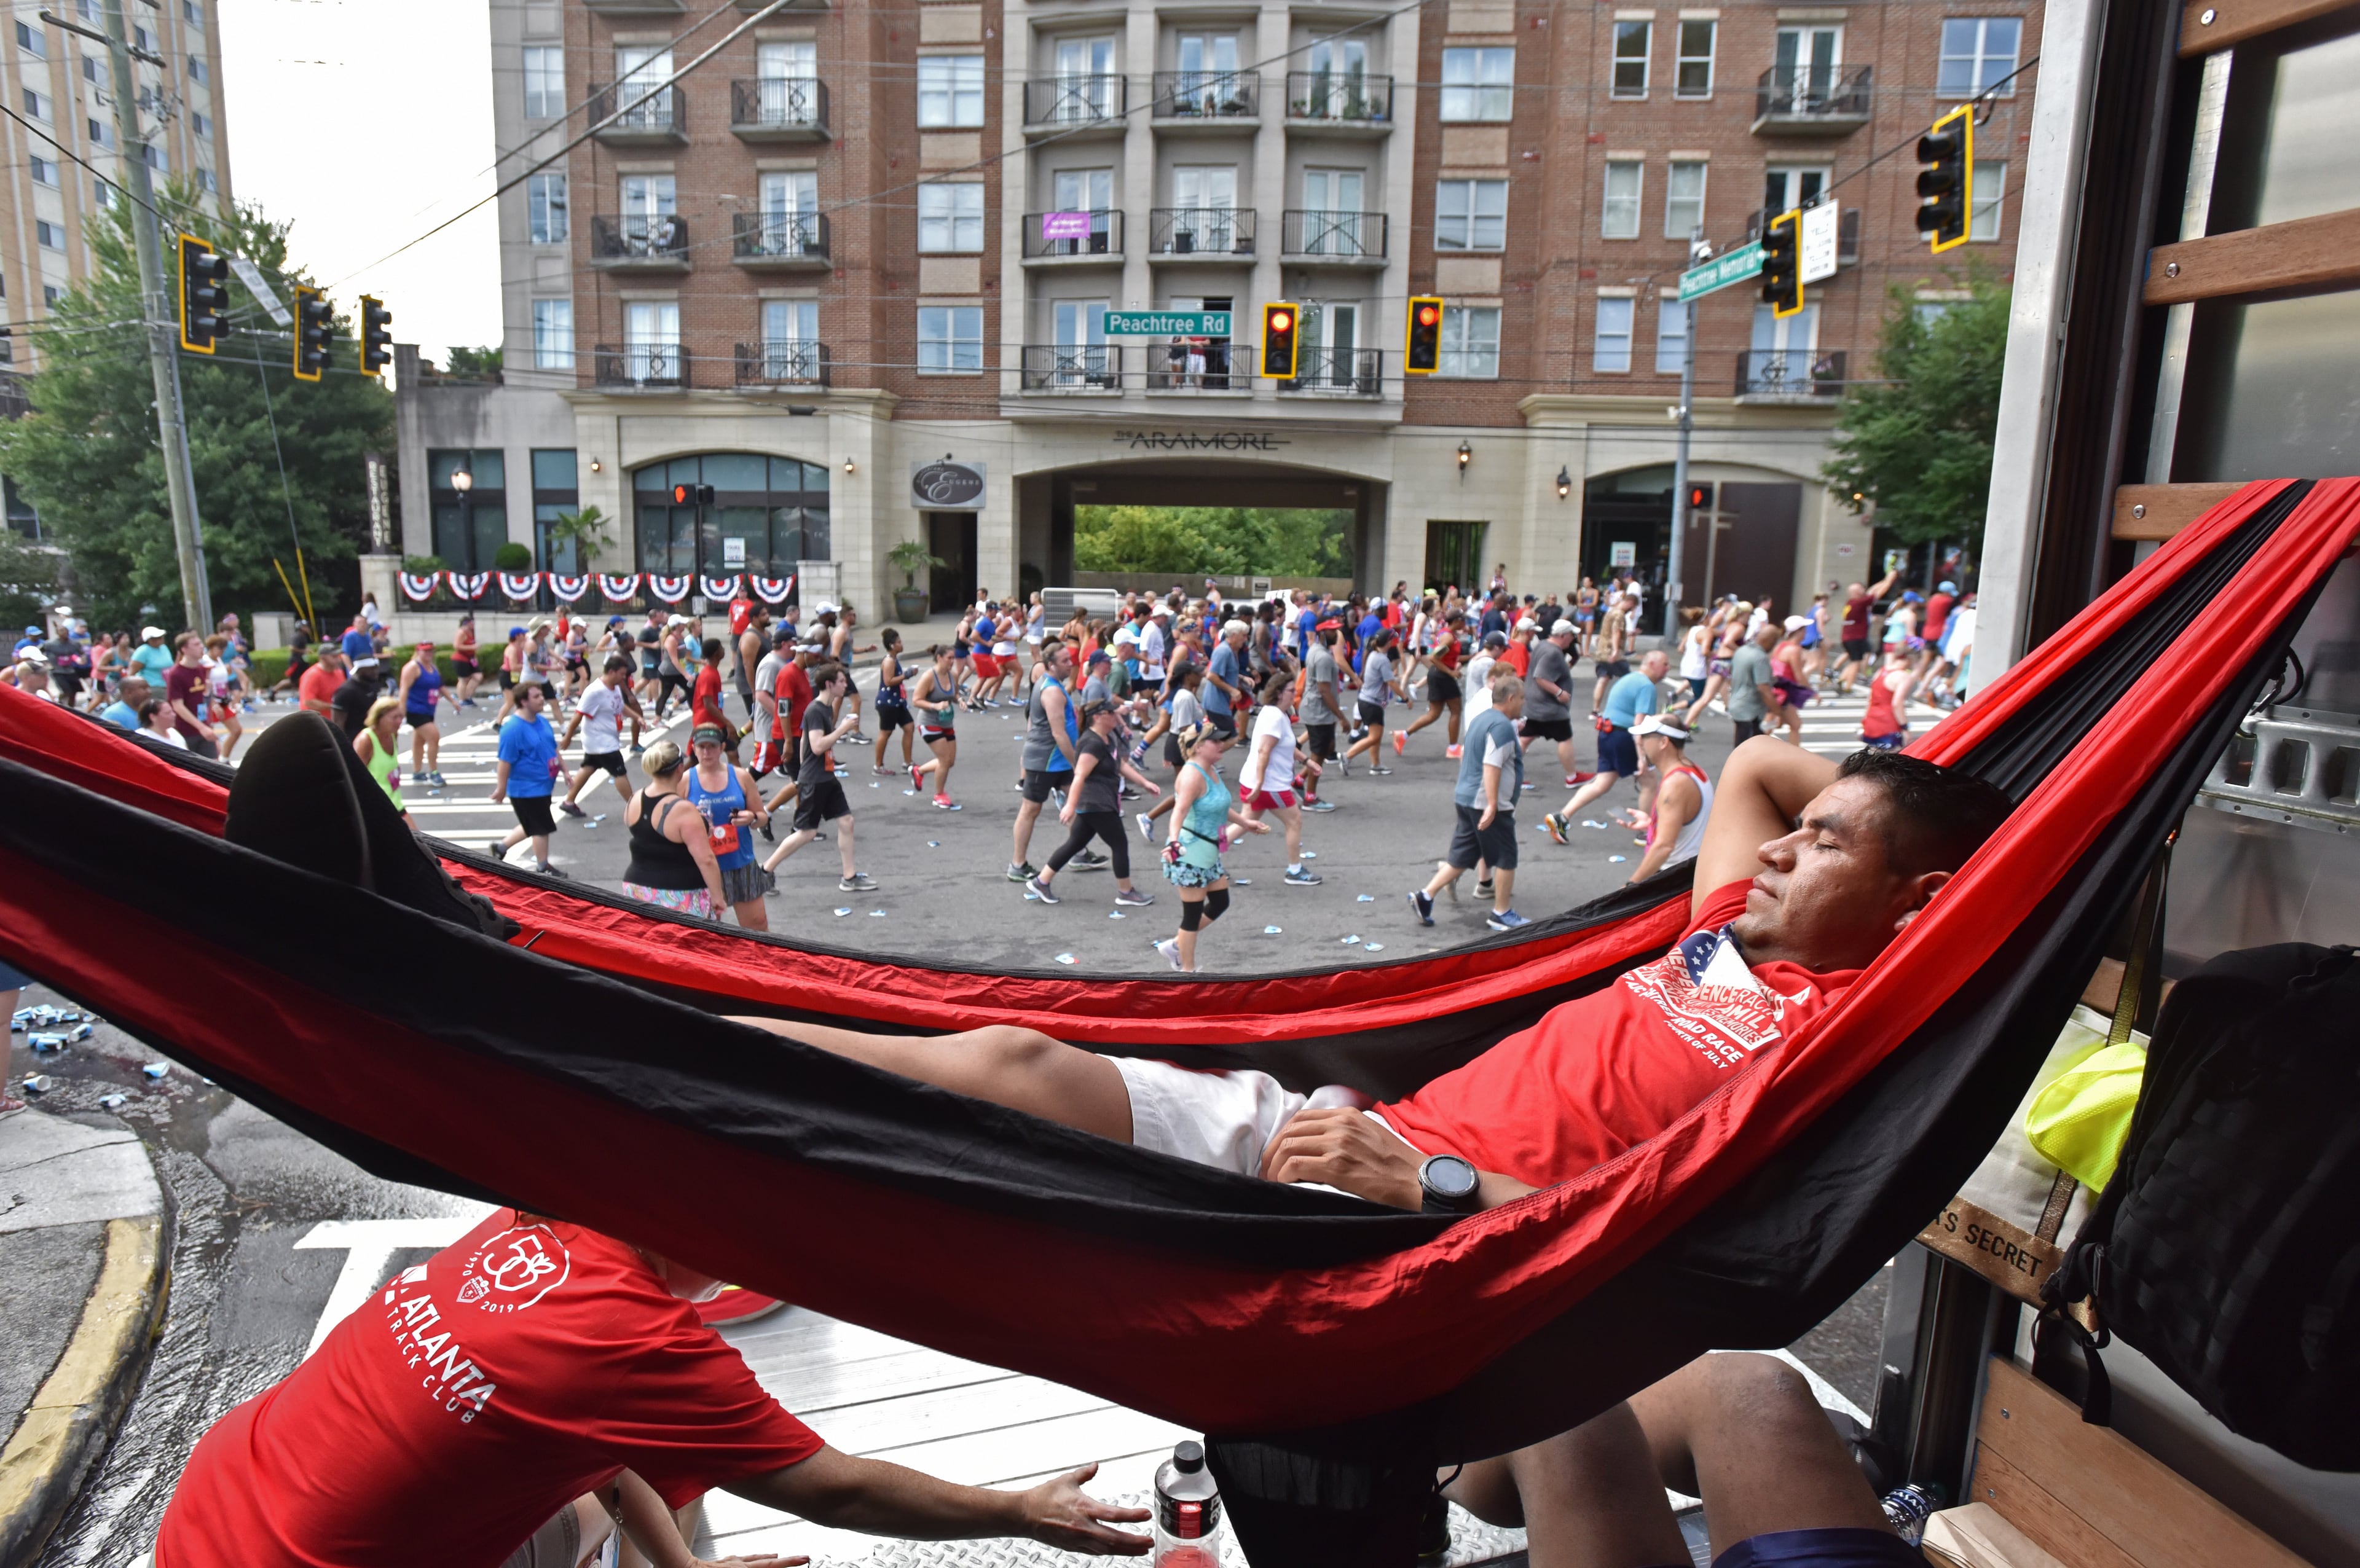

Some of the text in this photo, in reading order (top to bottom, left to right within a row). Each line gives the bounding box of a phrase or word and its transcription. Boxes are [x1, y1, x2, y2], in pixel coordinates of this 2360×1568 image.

[1110, 314, 1225, 332] Peachtree Rd
[1130, 431, 1278, 450] ARAMORE
[1670, 1017, 1707, 1034] ROAD
[1701, 1033, 1744, 1063] RACE
[1712, 1013, 1763, 1045] MEMORIES
[1691, 1040, 1706, 1050] OF
[1702, 1050, 1728, 1069] JULY
[462, 1251, 482, 1277] 1970
[1964, 1223, 2043, 1278] SECRET
[479, 1300, 514, 1314] 2019
[386, 1306, 476, 1424] TRACK CLUB
[399, 1293, 497, 1413] ATLANTA
